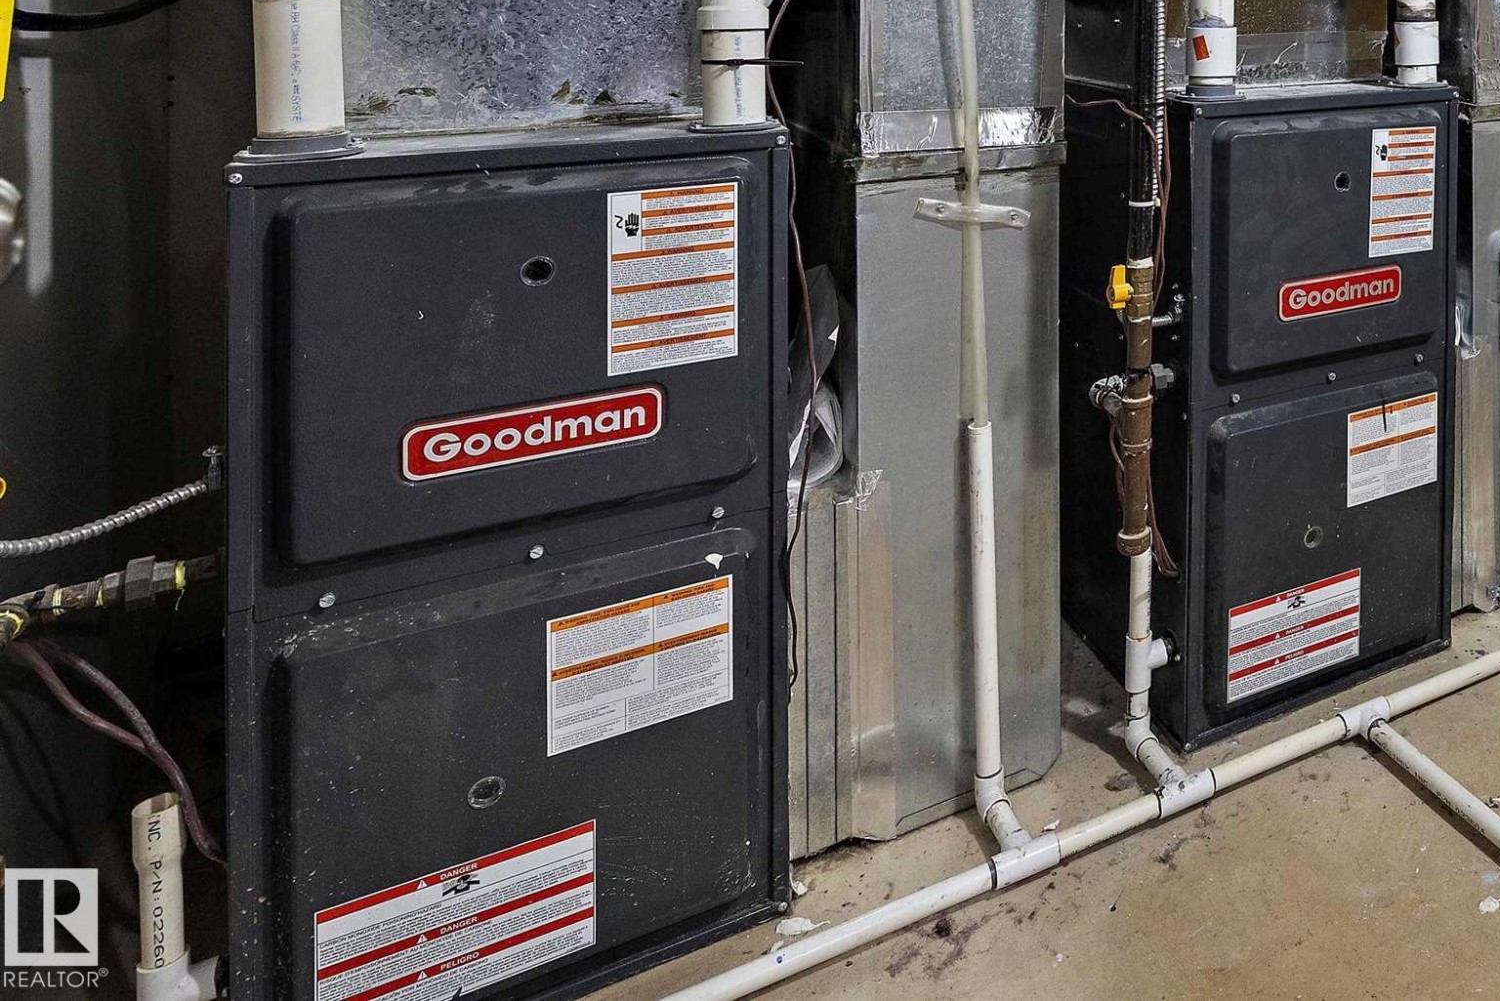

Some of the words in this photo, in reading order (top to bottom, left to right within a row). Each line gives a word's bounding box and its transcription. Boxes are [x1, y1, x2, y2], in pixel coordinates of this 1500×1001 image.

[1289, 278, 1394, 310] Goodman
[424, 406, 646, 463] Goodman
[1286, 588, 1305, 598] DANGER
[1285, 625, 1304, 635] DANGER
[440, 862, 478, 880] DANGER
[319, 935, 346, 949] CARBON
[347, 924, 382, 941] MONOXIDE
[382, 911, 417, 929] POISONING
[417, 902, 442, 917] HAZARD
[440, 916, 478, 934] DANGER
[440, 951, 480, 971] PELIGRO
